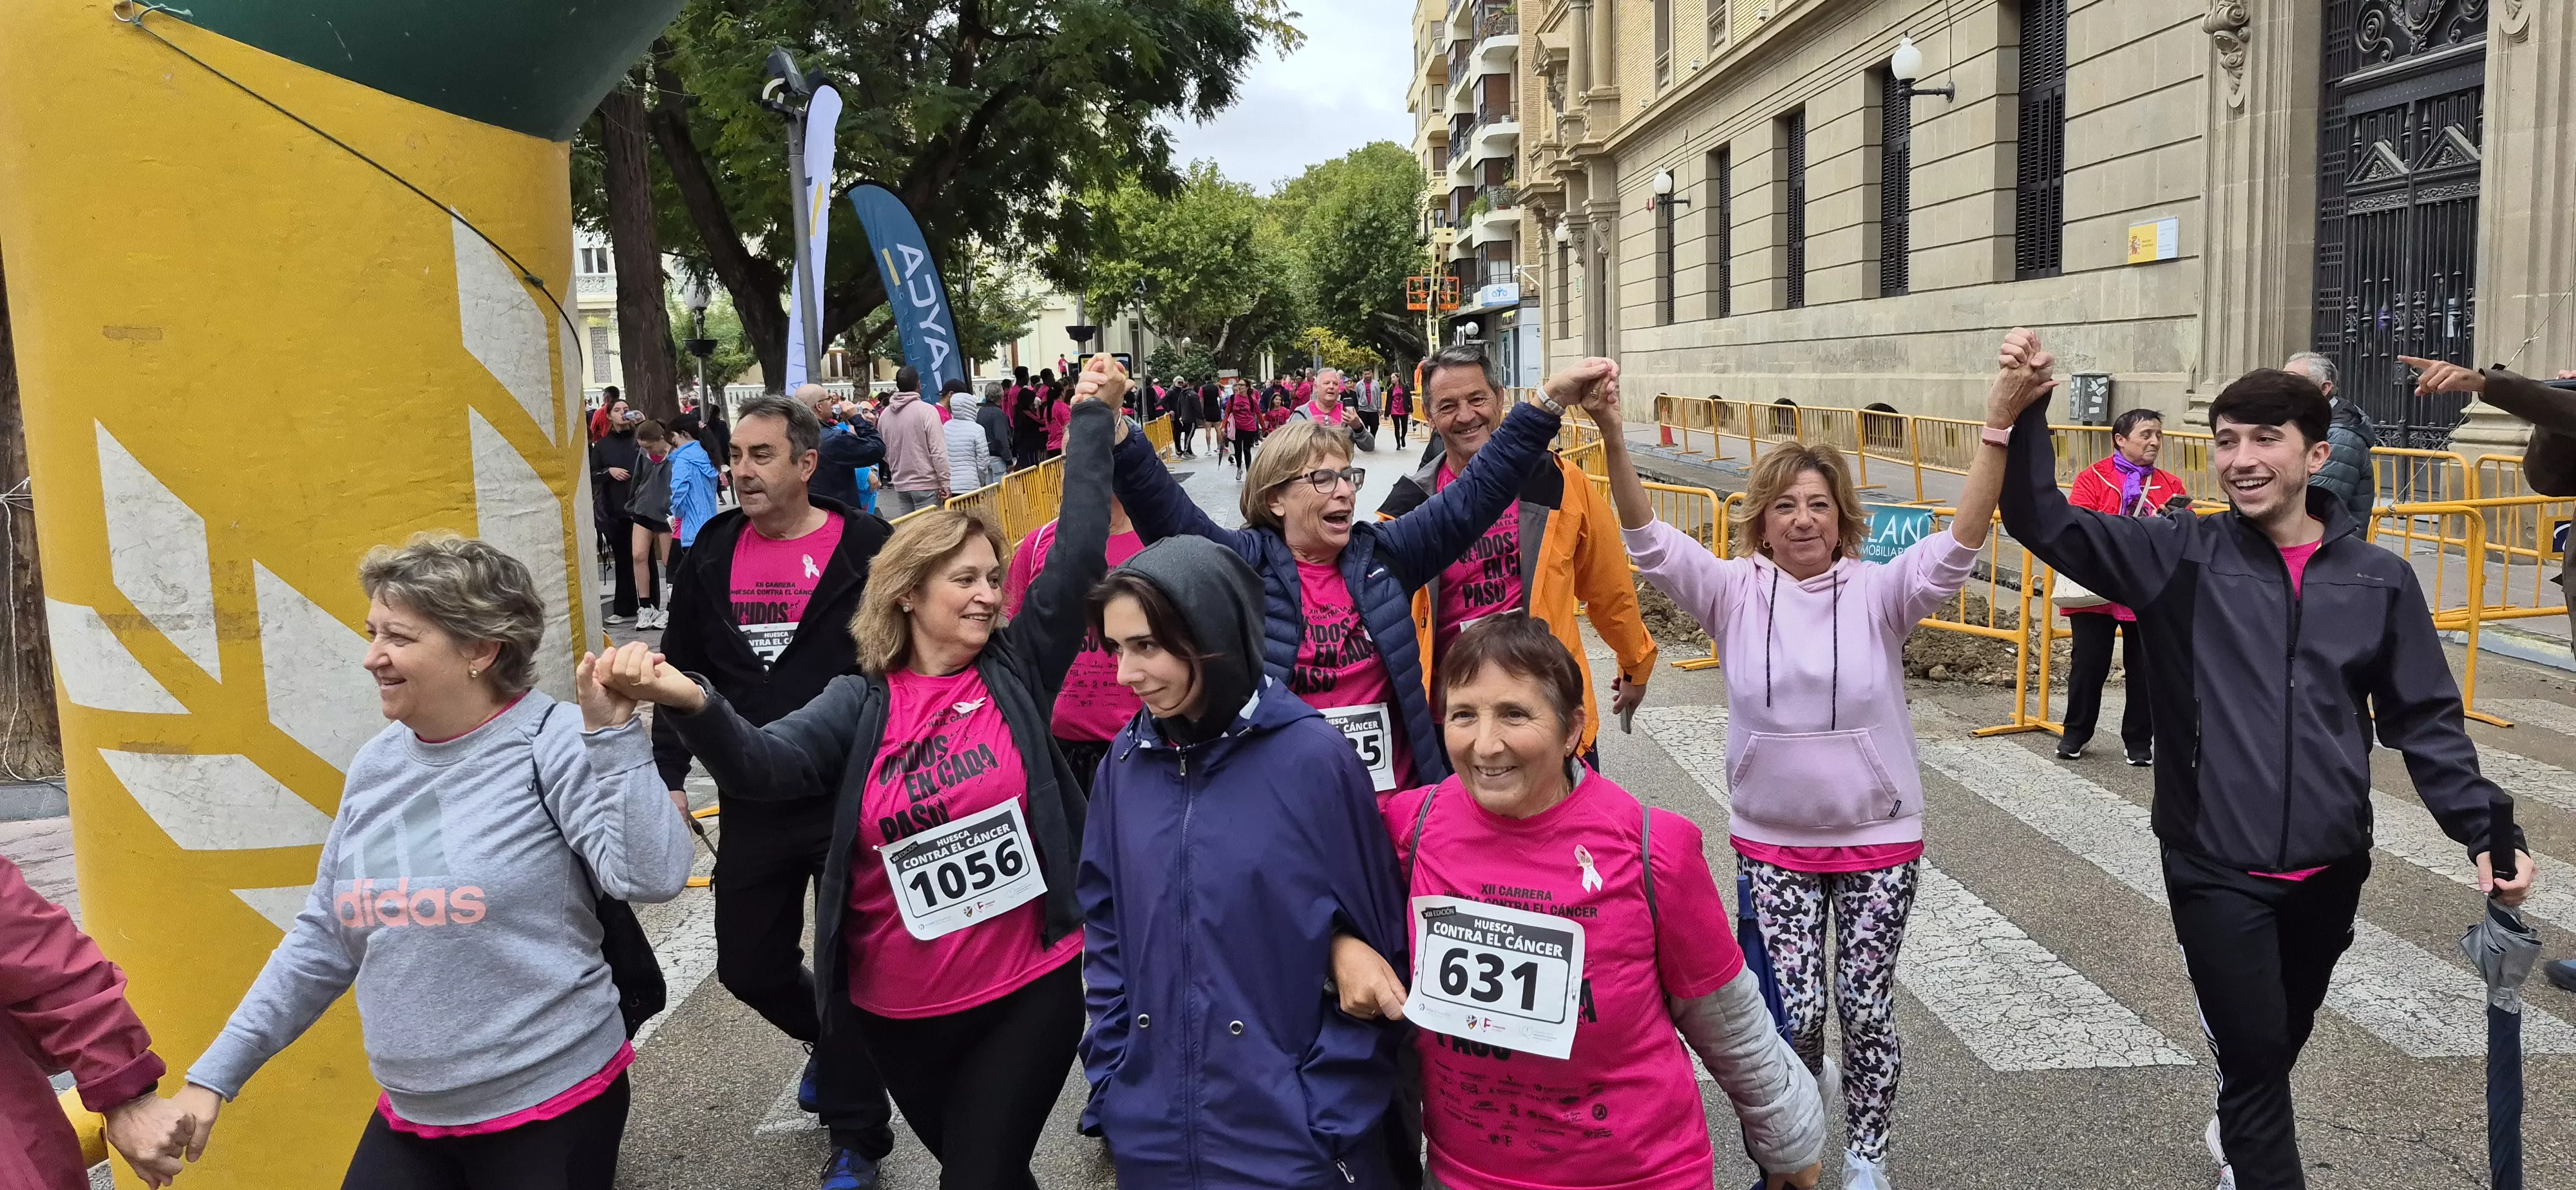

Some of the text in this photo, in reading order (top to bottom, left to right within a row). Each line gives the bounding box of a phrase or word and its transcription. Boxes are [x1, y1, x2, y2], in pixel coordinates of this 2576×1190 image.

[1483, 556, 1504, 580] EN
[1462, 581, 1507, 609] PASO
[1314, 644, 1338, 667] EN
[1294, 666, 1338, 694] ASO
[1343, 721, 1379, 733] CÁNCER
[879, 735, 949, 786] UNDOS
[1348, 734, 1381, 766] 5
[904, 743, 999, 804] EN CADA
[878, 798, 950, 844] PASO
[899, 842, 918, 859] EDICIÓN
[903, 823, 1011, 869] CONTRA EL CÁNCER
[936, 830, 971, 847] HUESCA
[909, 837, 1023, 907] 1056
[334, 876, 487, 928] adidas
[1481, 884, 1553, 901] XII CARRERA
[1433, 907, 1455, 917] EDICIÓN
[1533, 904, 1546, 914] EL
[1550, 904, 1598, 918] CÁNCER
[1434, 921, 1563, 957] CONTRA EL CÁNCER
[1474, 919, 1515, 934] HUESCA
[1439, 947, 1539, 1011] 631
